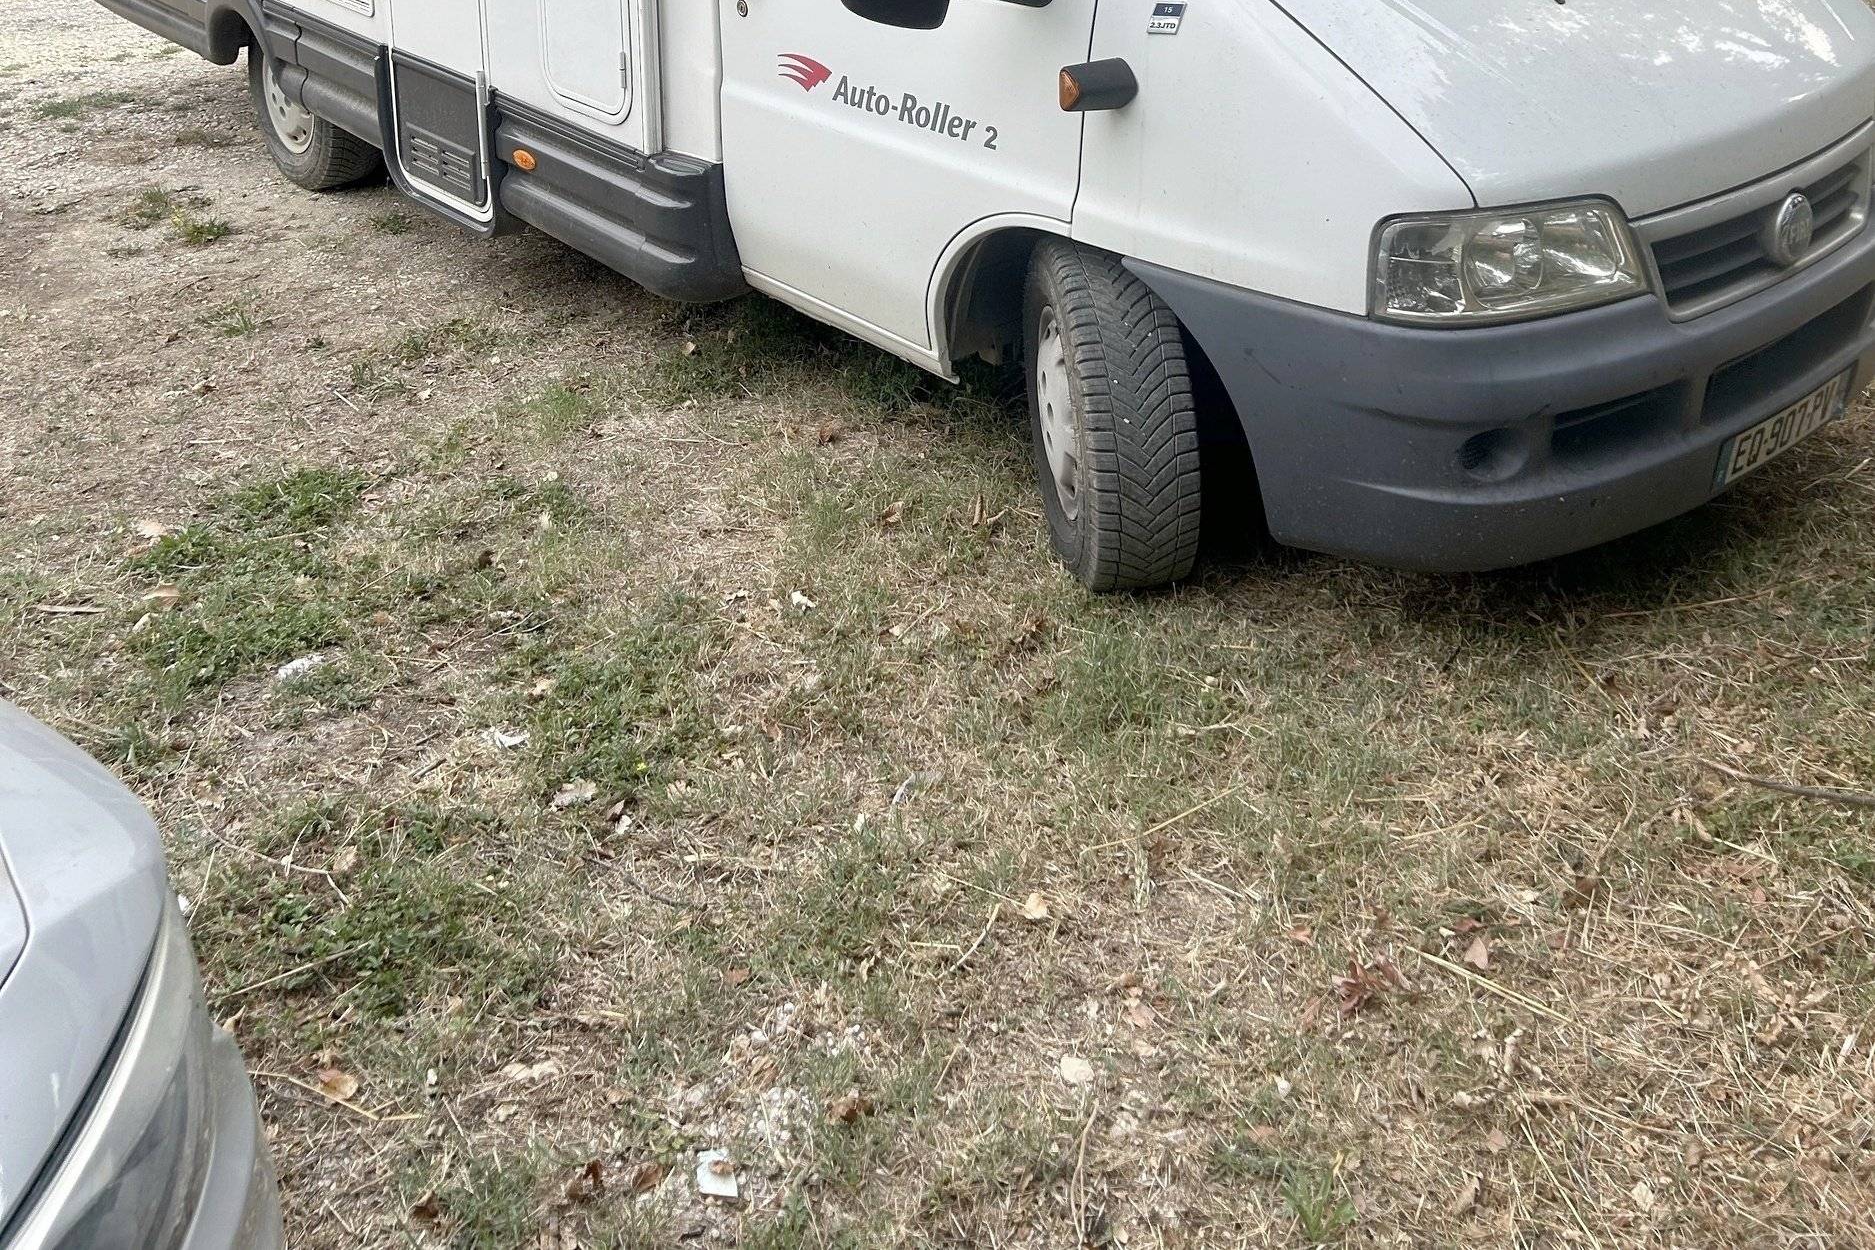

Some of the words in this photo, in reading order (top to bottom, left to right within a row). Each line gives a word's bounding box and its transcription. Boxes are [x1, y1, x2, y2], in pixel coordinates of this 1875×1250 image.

[832, 75, 977, 141] Auto-Roller
[983, 125, 998, 150] 2
[1731, 381, 1838, 475] EQ-907-PV
